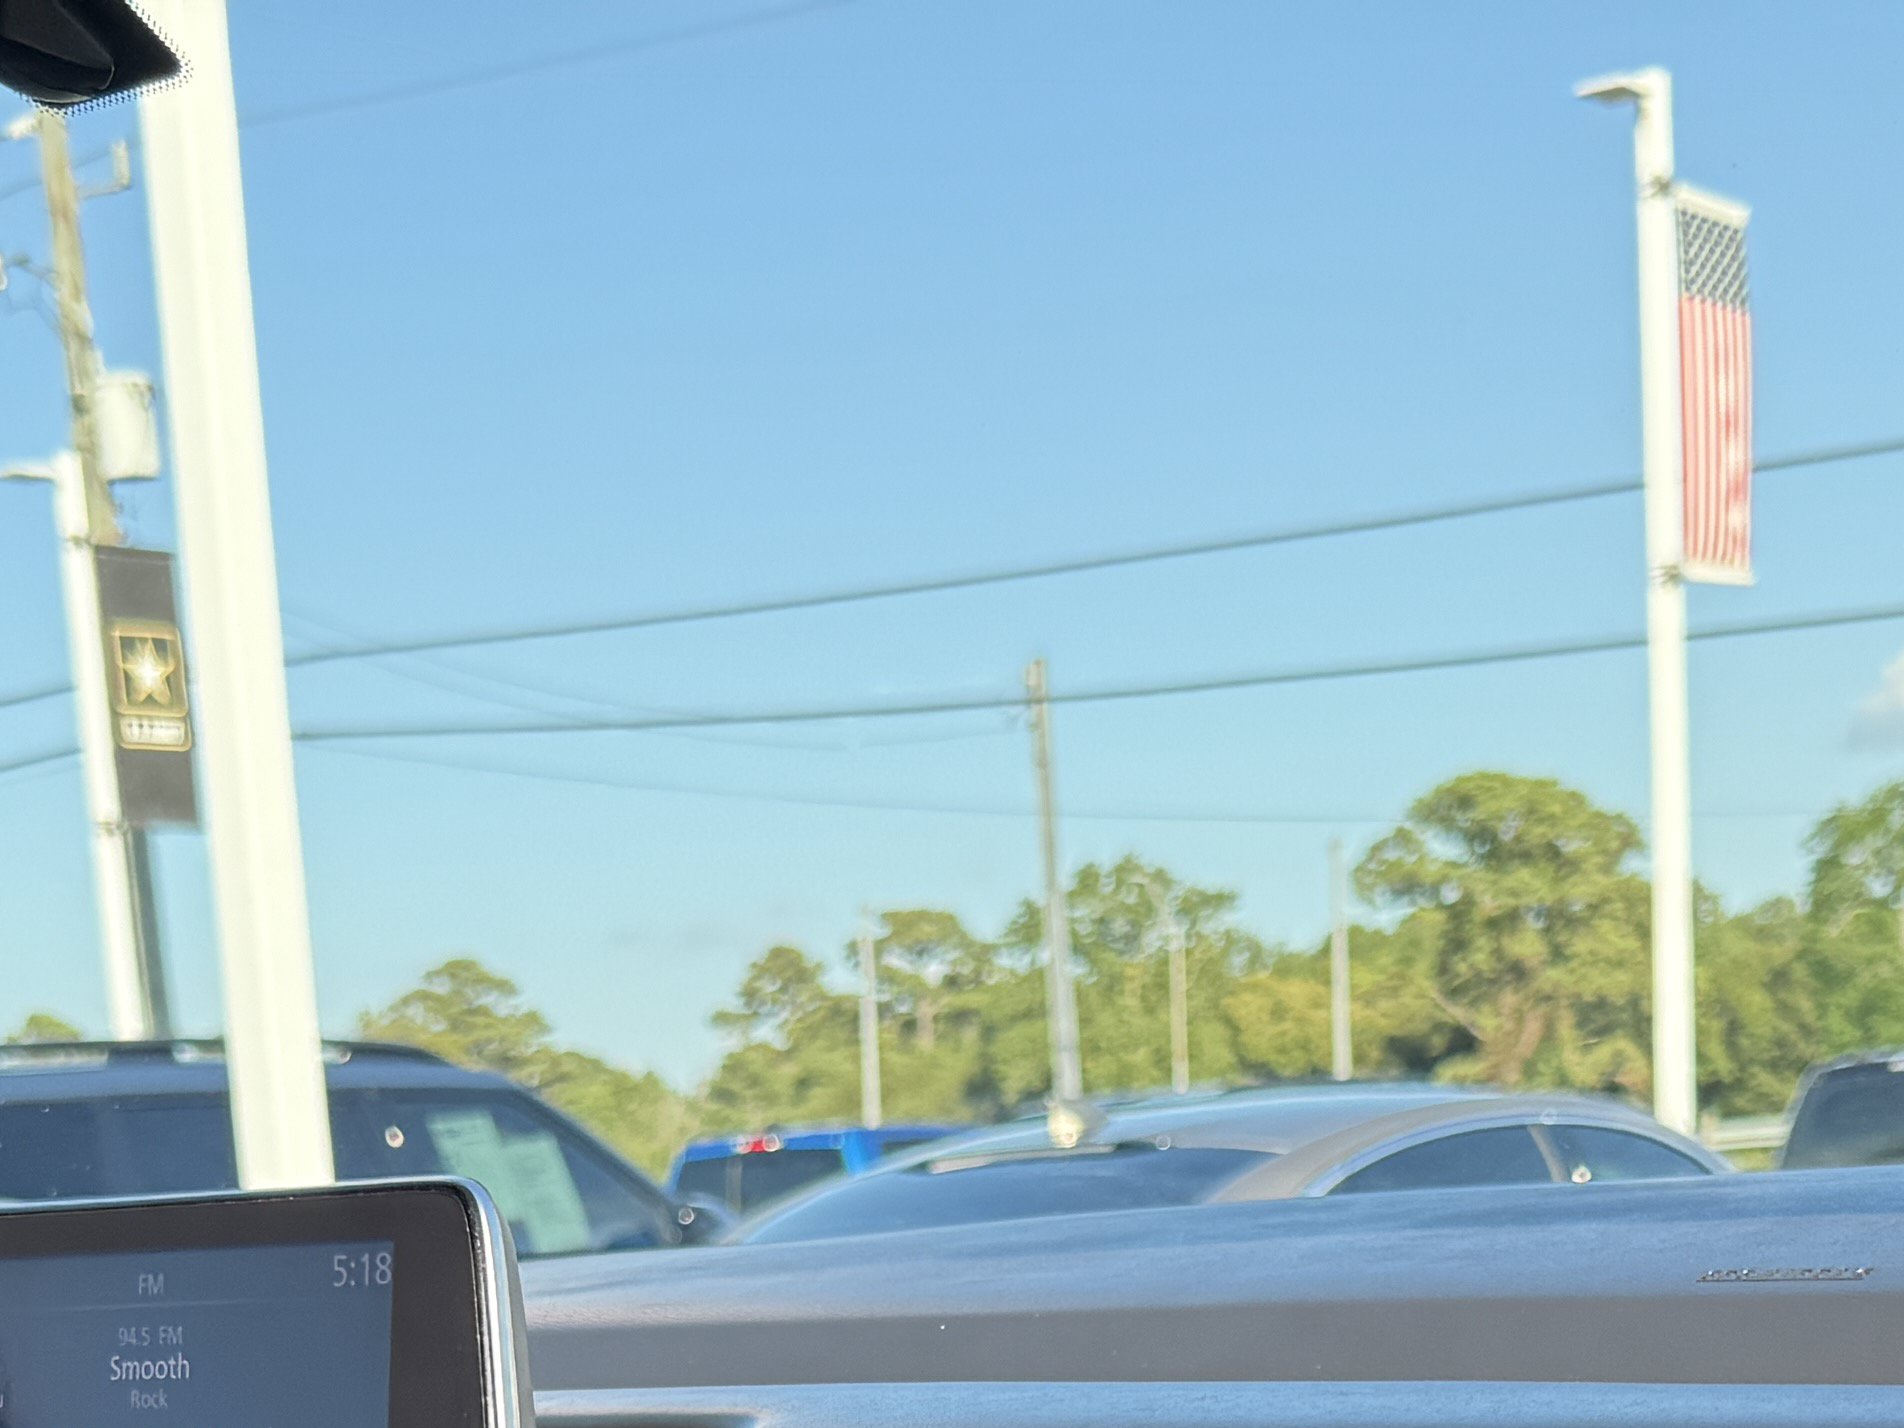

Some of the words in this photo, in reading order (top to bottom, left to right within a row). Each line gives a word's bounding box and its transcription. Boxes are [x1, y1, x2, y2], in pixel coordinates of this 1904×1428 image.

[332, 1252, 393, 1288] 5:18
[138, 1273, 164, 1296] FM
[118, 1326, 151, 1347] 94.5
[158, 1325, 183, 1346] FM
[109, 1351, 191, 1382] Smooth
[130, 1388, 169, 1409] Rock
